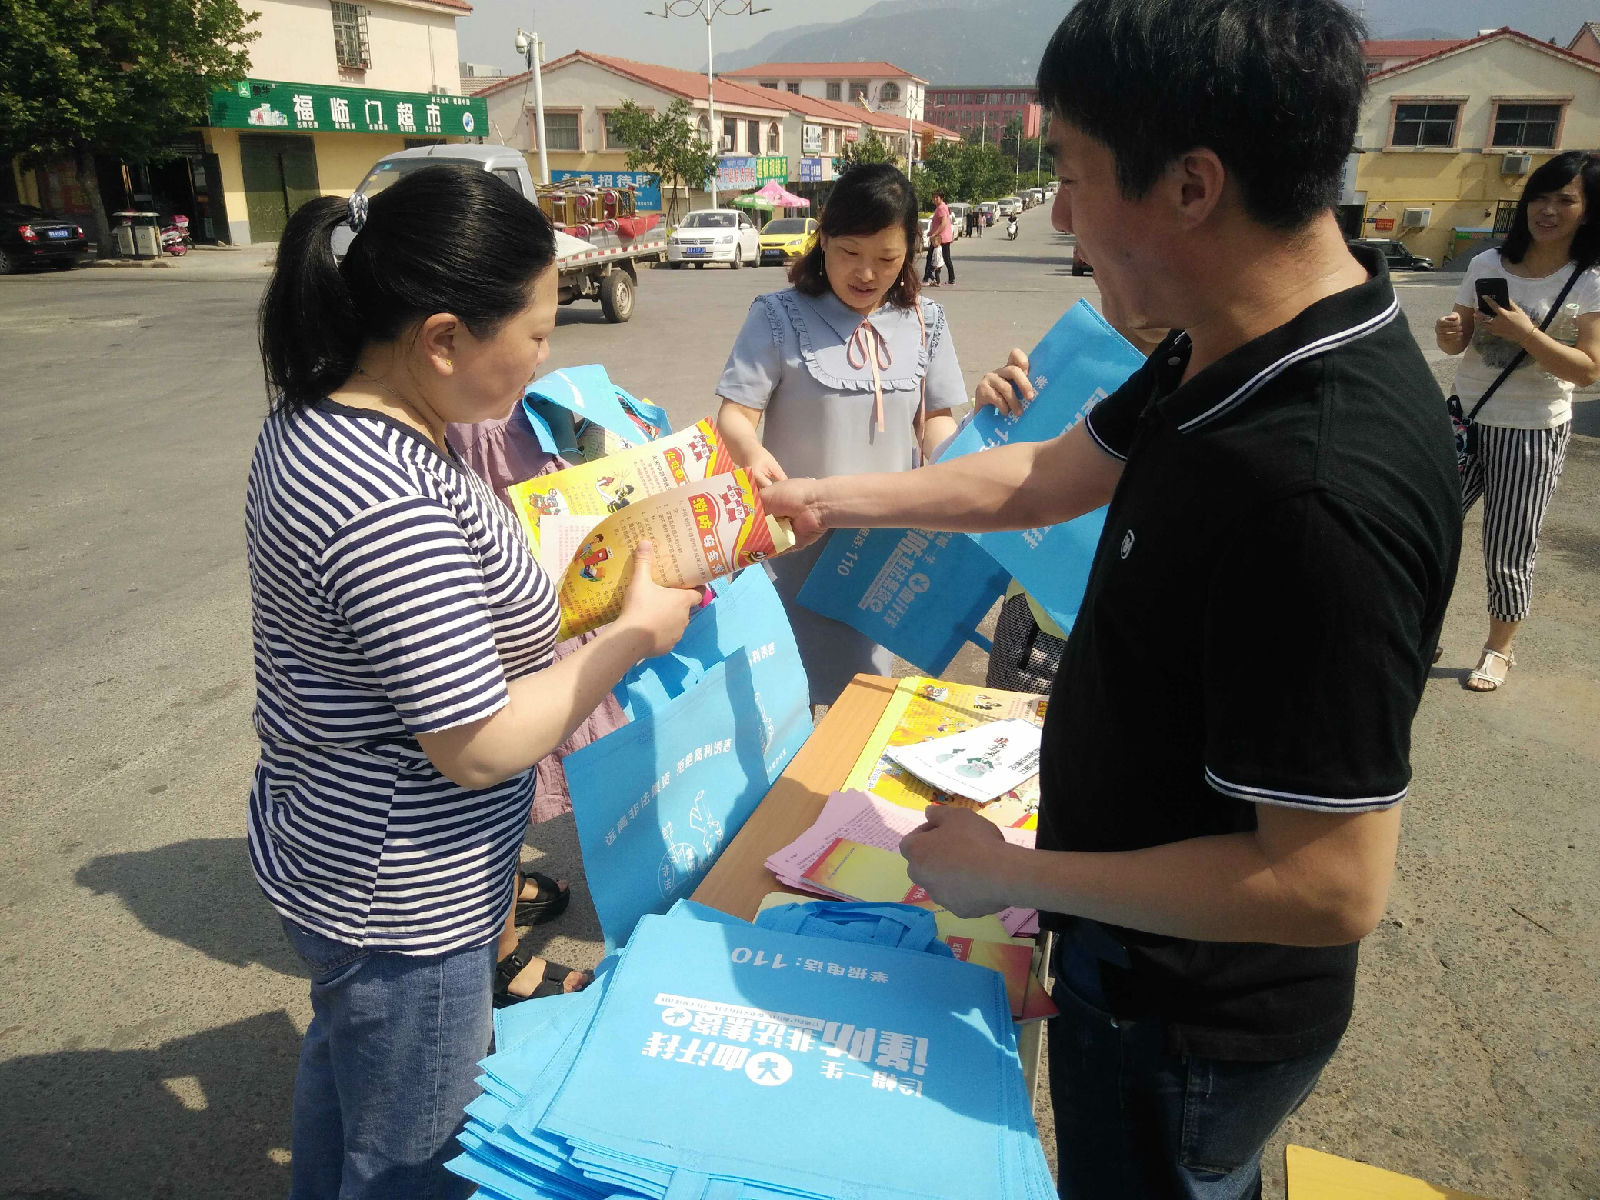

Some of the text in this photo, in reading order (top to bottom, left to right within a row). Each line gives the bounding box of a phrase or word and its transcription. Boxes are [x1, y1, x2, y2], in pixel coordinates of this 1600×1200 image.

[293, 94, 441, 127] 福临门超市
[642, 1031, 751, 1072] 血汗钱
[690, 1011, 929, 1076] 谨防非法集资
[820, 1060, 923, 1098] 珍惜一生
